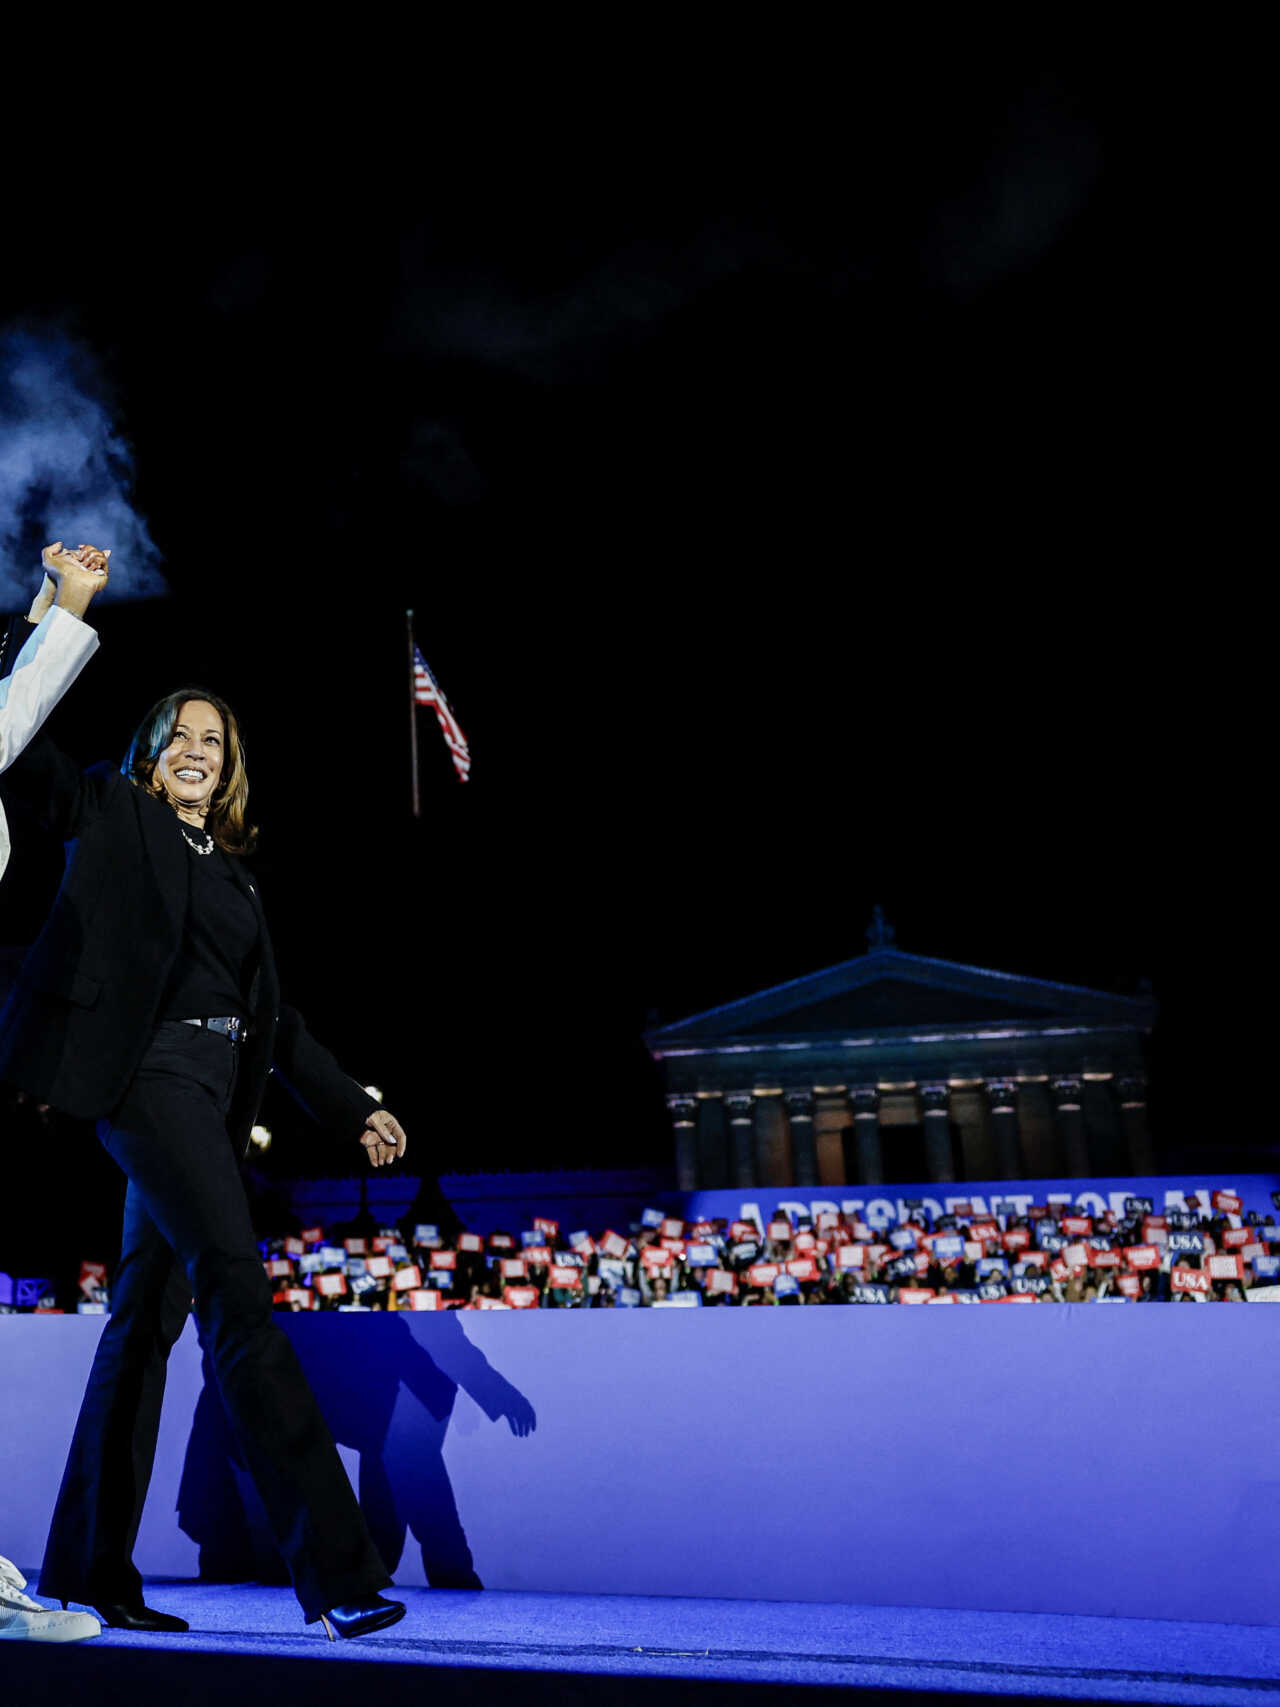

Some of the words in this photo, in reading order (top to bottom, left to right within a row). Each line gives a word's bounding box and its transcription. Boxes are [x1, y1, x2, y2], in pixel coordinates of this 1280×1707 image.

[1126, 1199, 1152, 1212] USA
[1169, 1234, 1203, 1250] USA
[1173, 1272, 1210, 1290] USA
